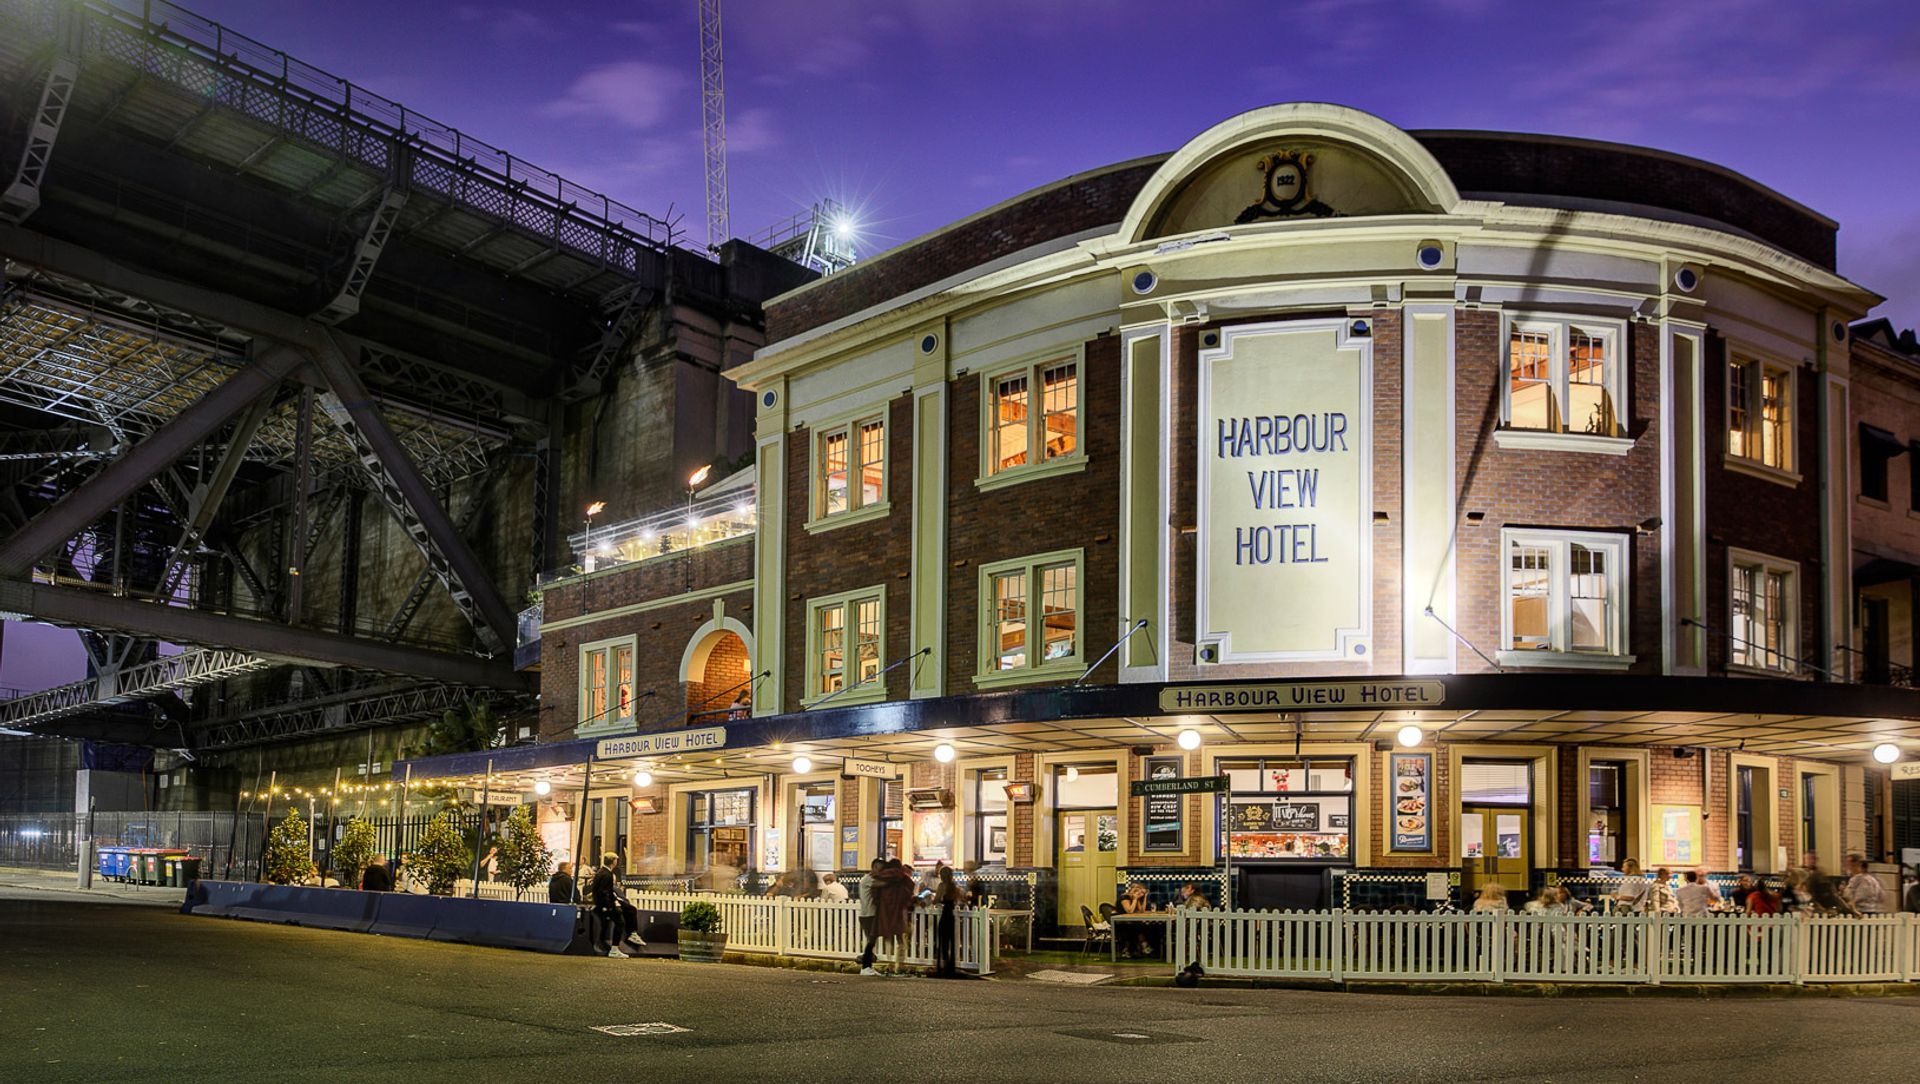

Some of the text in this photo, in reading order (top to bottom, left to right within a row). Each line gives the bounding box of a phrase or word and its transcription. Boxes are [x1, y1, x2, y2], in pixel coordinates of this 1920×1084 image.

[1277, 174, 1295, 187] 1922
[1217, 412, 1348, 459] HARBOUR
[1247, 468, 1319, 509] VIEW
[1236, 524, 1328, 565] HOTEL
[1176, 685, 1429, 707] HARBOUR VIEW HOTEL
[604, 732, 718, 756] HARBOUR VIEW HOTEL
[856, 763, 885, 774] TOOHEYS
[1144, 780, 1215, 792] CUMBERLAND ST
